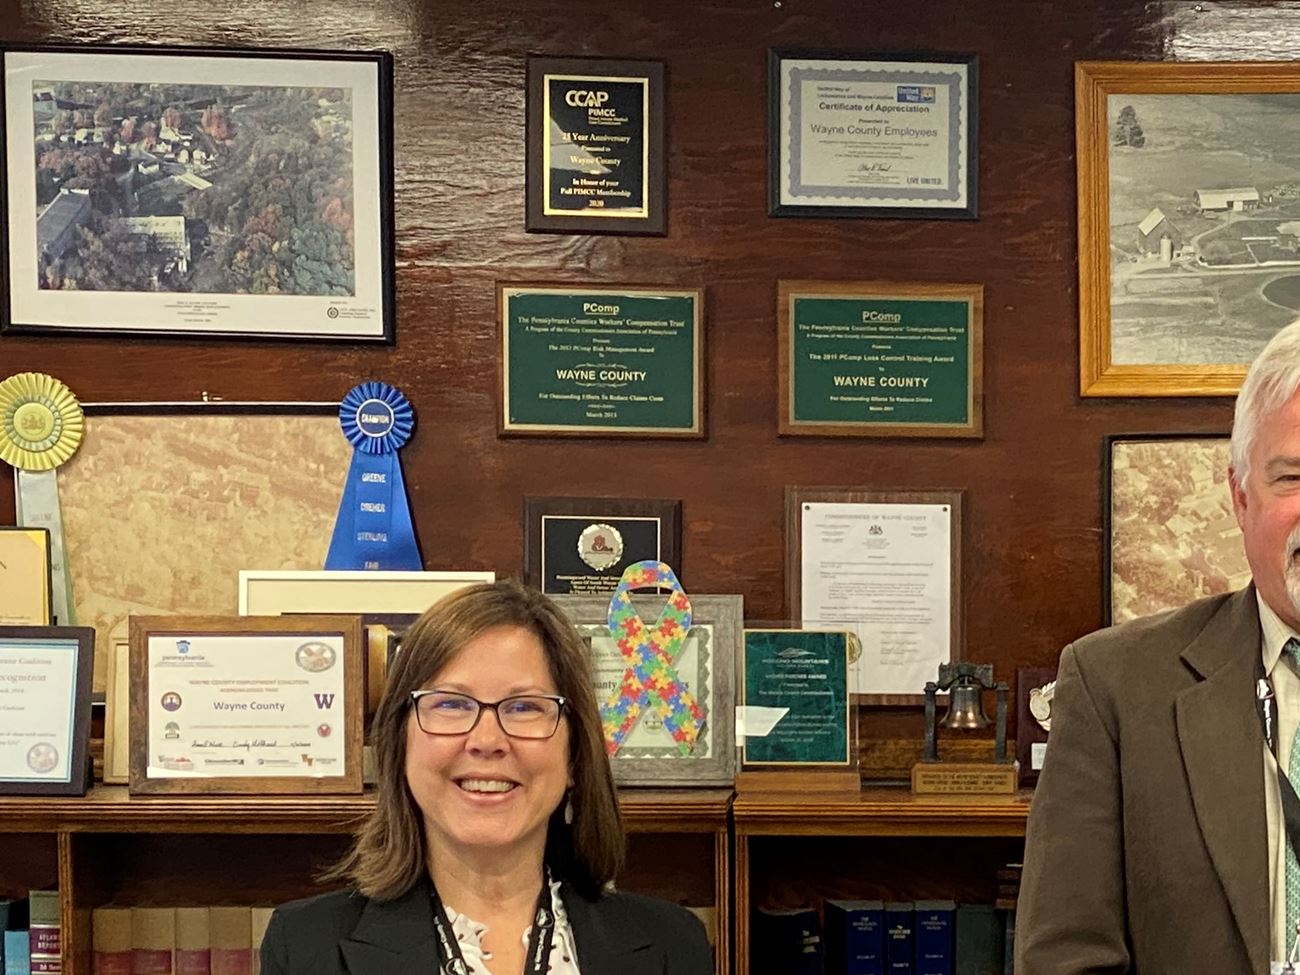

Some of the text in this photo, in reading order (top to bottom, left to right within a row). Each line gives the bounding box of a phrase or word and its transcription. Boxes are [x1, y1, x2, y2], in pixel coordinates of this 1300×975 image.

[565, 90, 609, 107] CCAP
[588, 108, 616, 117] PIMCC
[819, 102, 862, 111] Certificate
[876, 104, 930, 113] Appreciation
[811, 124, 938, 138] Wayne County Employees
[572, 133, 589, 141] Year
[590, 134, 631, 144] Anniversary
[570, 156, 621, 166] Wayne County
[583, 303, 620, 315] PComp
[531, 317, 569, 325] Pennsylvania
[863, 311, 901, 322] PComp
[556, 370, 646, 381] WAYNE COUNTY
[834, 376, 928, 388] WAYNE COUNTY
[313, 693, 335, 709] W
[213, 702, 285, 712] Wayne County
